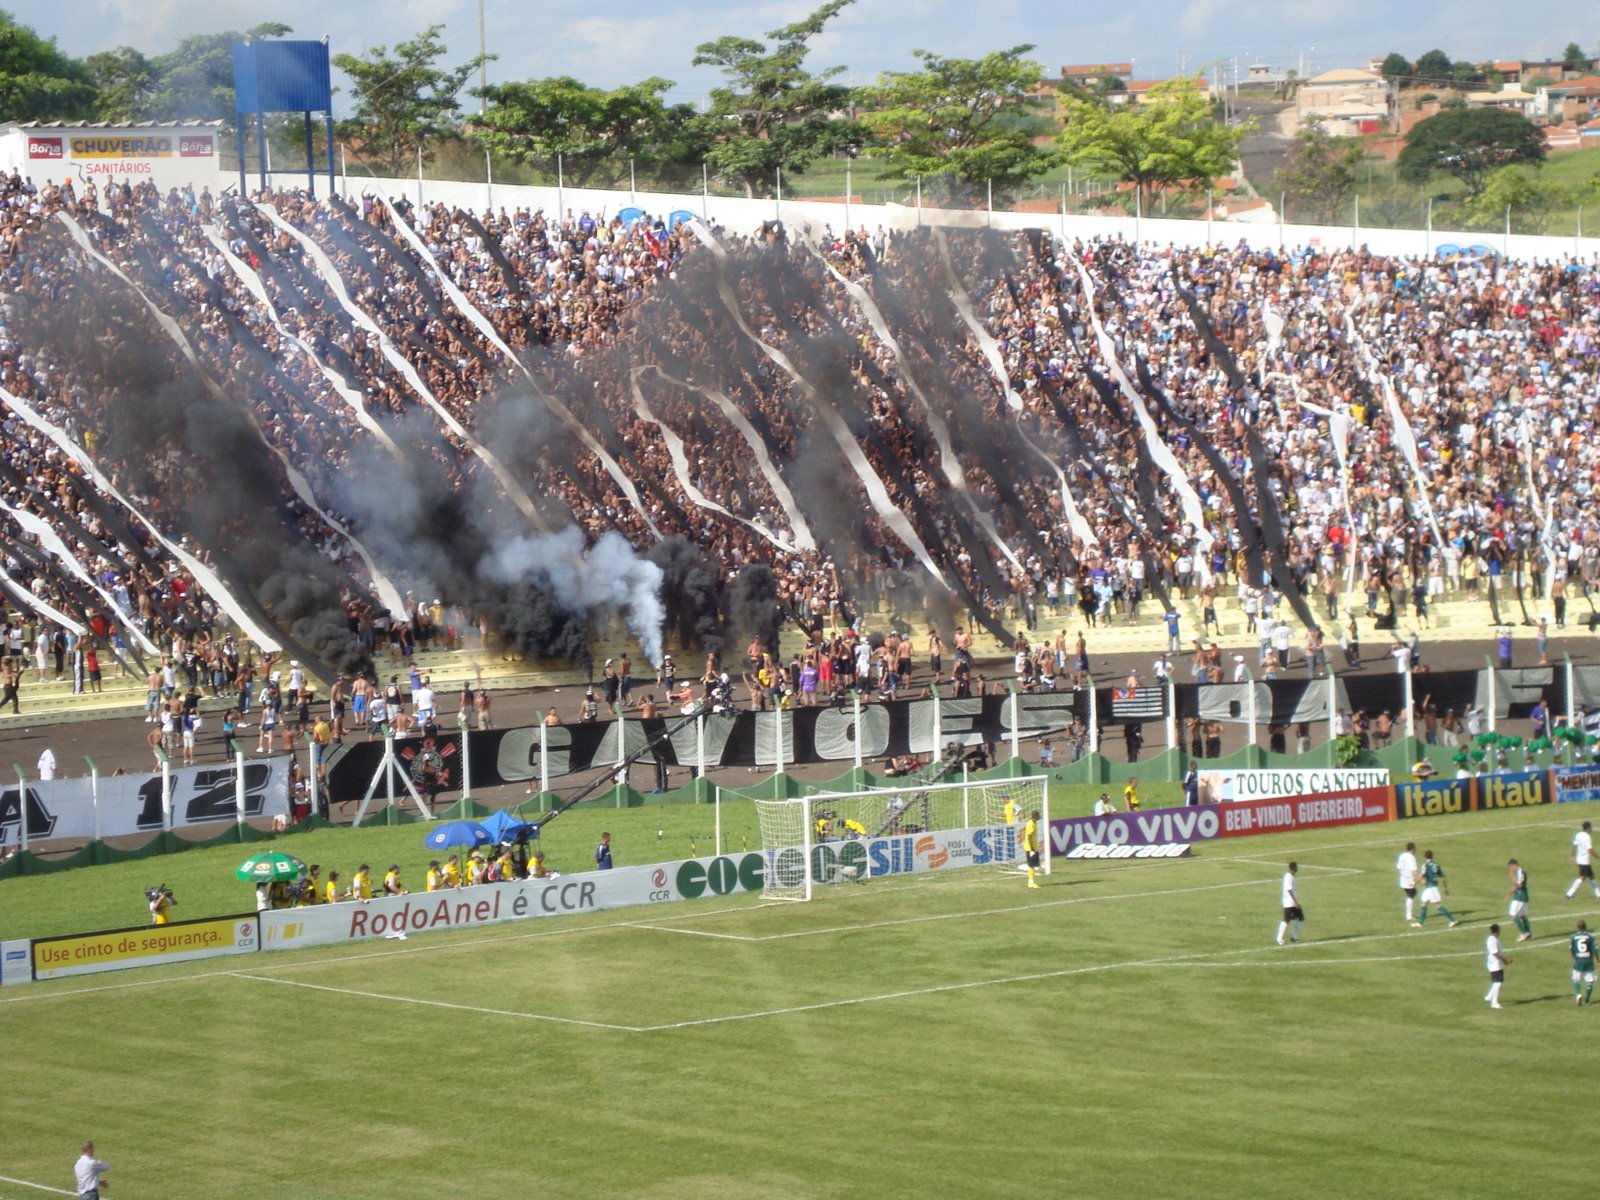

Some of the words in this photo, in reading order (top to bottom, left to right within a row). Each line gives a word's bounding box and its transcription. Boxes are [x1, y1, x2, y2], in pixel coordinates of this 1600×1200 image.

[73, 137, 171, 153] CHUVEIRÃO
[86, 161, 151, 174] SANITÁRIOS
[137, 764, 271, 830] 12
[1236, 773, 1304, 795] TOUROS
[1310, 772, 1389, 794] CANCHIM
[1403, 780, 1462, 817] Itaú
[1485, 773, 1543, 809] Itaú
[1051, 818, 1130, 852] VIVO
[1137, 810, 1219, 843] VIVO
[1225, 804, 1296, 832] BEM-VINDO,
[1298, 797, 1364, 824] GUERREIRO
[869, 837, 914, 876] Sil
[1067, 842, 1190, 858] Gatorade
[350, 891, 501, 938] RodoAnel
[512, 889, 527, 916] é
[540, 881, 596, 913] CCR
[649, 889, 670, 902] CCR
[42, 948, 70, 963] Use
[75, 943, 113, 959] cinto
[118, 939, 137, 953] de
[142, 931, 223, 953] segurança.
[1577, 938, 1587, 953] 6
